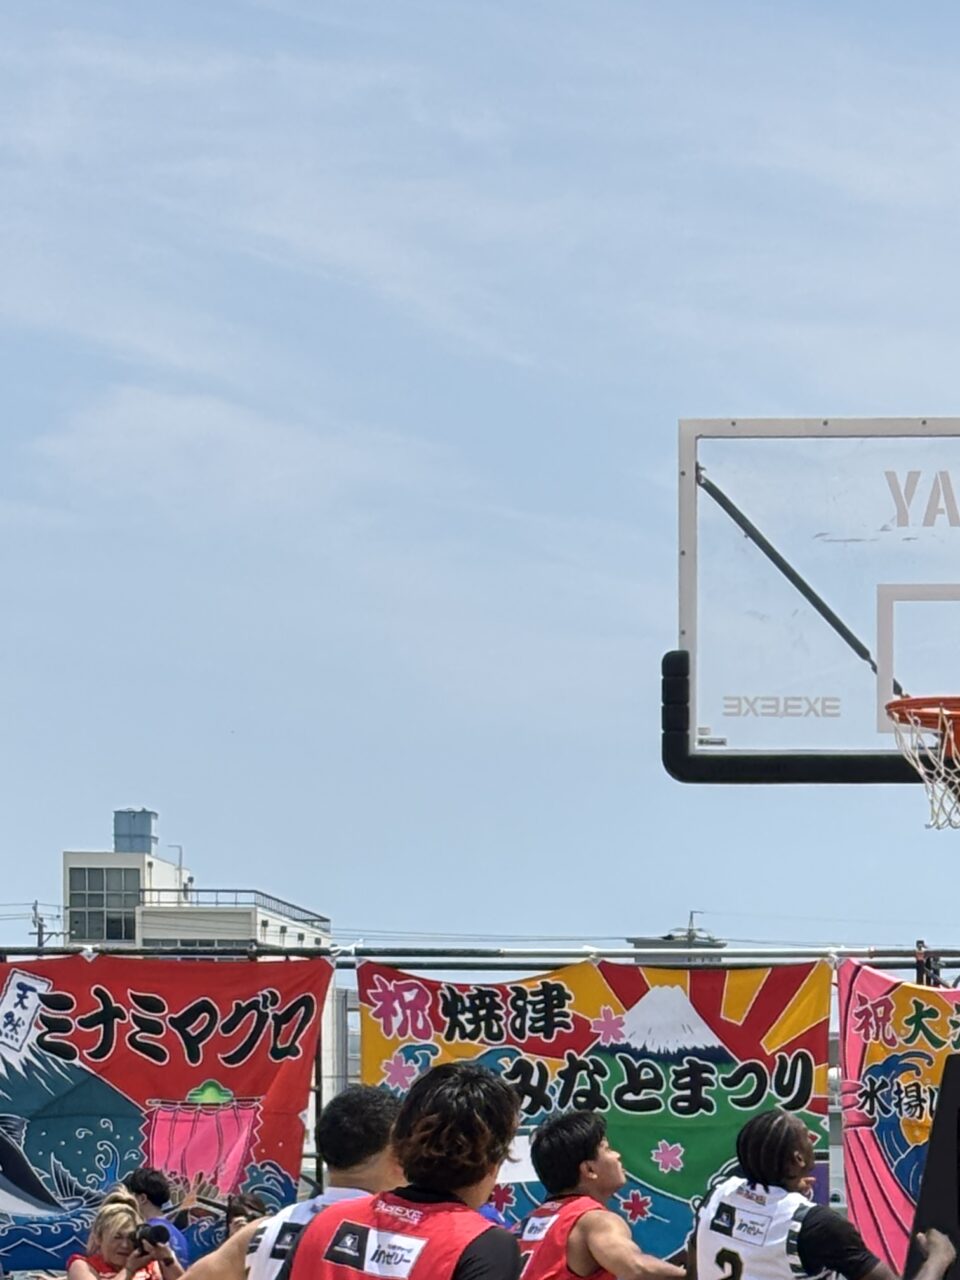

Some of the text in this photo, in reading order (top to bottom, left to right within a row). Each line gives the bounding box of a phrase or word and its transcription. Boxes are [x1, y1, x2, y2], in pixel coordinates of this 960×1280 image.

[36, 985, 316, 1066] ミナミマグロ
